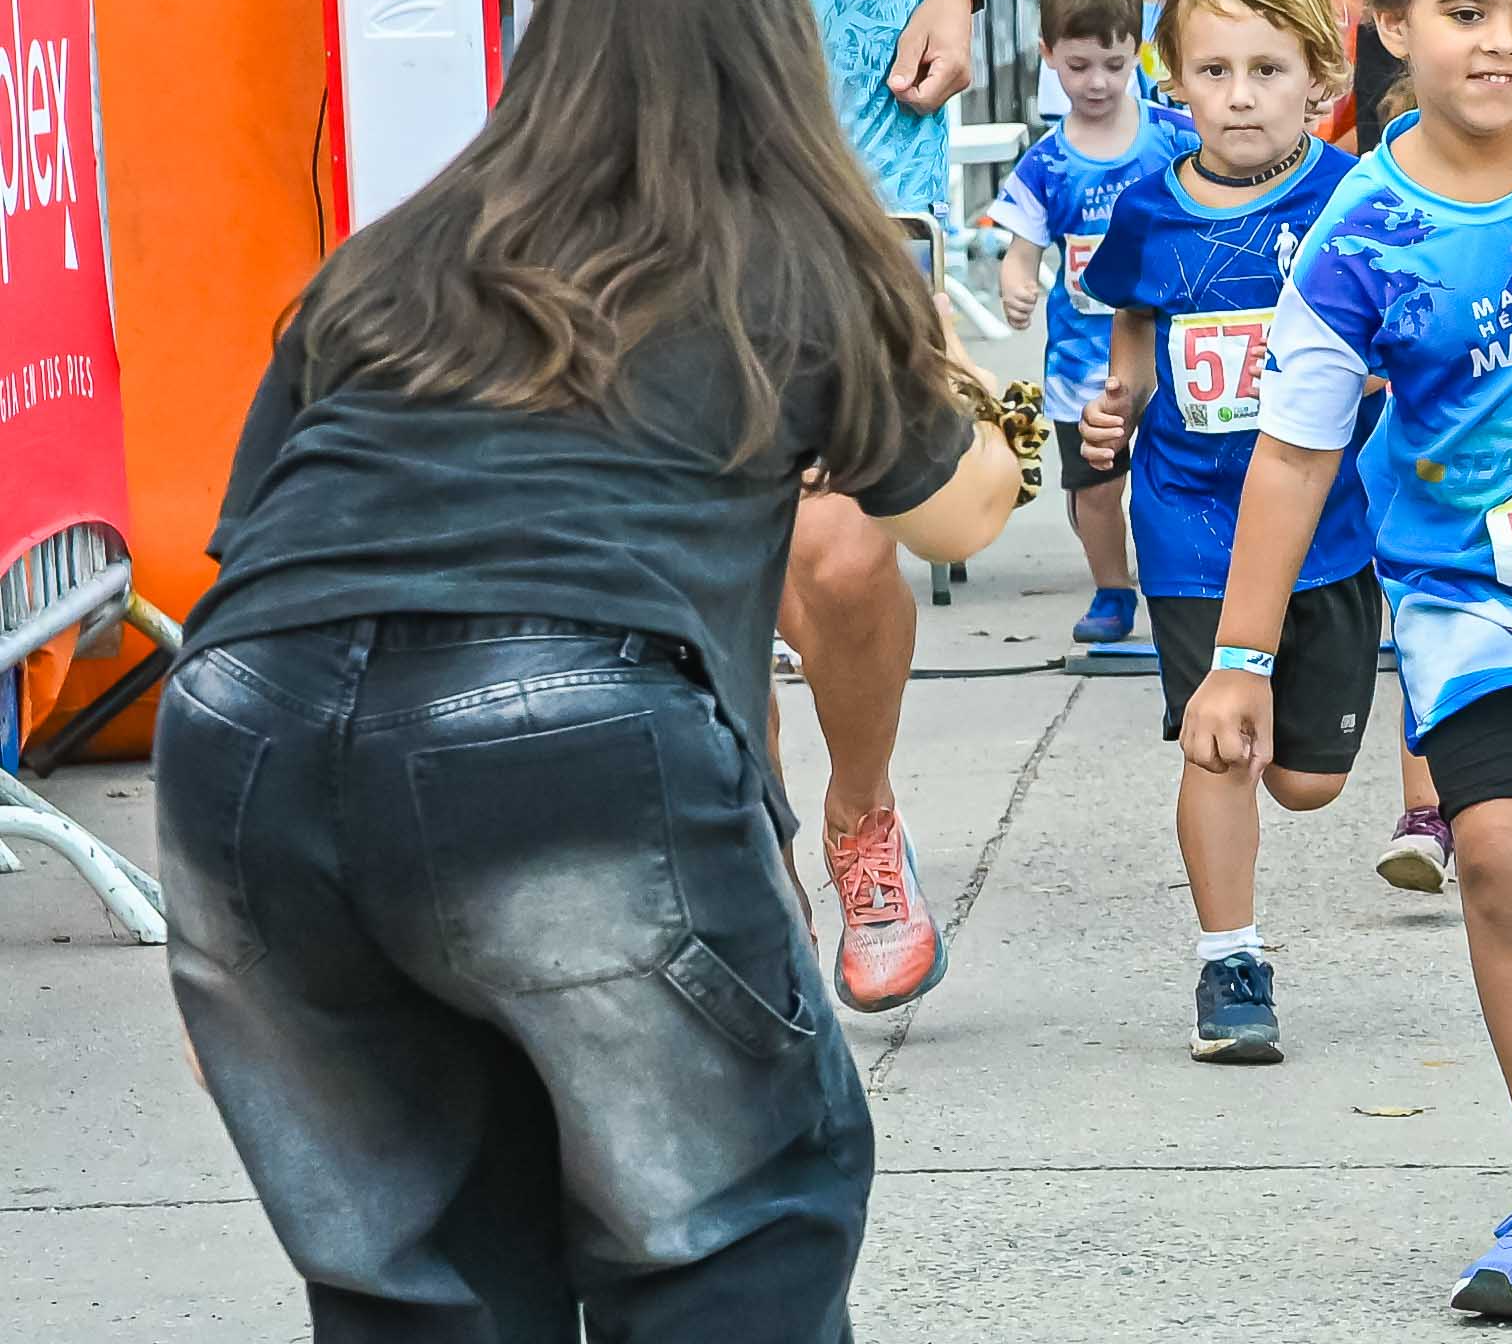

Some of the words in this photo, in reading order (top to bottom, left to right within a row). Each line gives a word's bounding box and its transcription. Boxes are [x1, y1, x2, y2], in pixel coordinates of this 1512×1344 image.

[25, 364, 37, 408] EN
[41, 357, 62, 401] TUS
[67, 353, 94, 399] PIES
